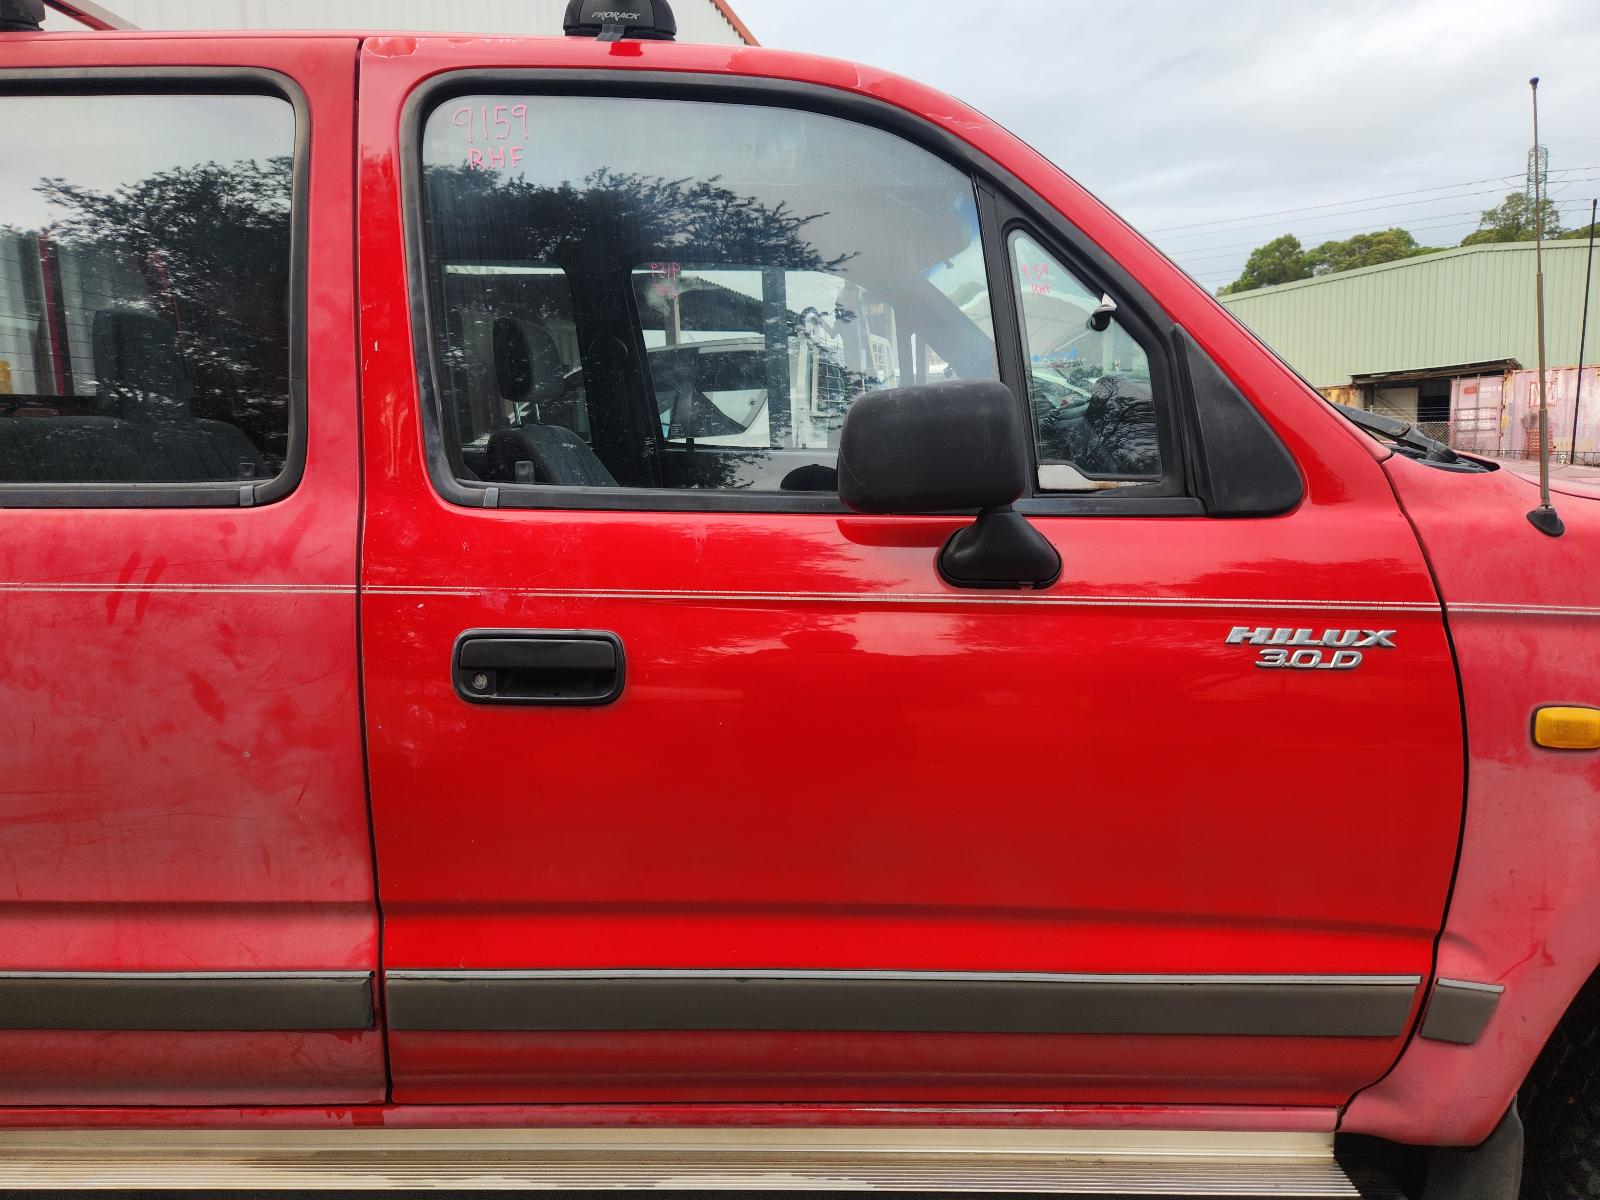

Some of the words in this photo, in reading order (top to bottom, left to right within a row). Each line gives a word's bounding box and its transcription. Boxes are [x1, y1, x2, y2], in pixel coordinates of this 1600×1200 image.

[591, 11, 641, 21] PRORACK
[451, 102, 528, 144] 9159
[469, 145, 523, 171] RHF
[1225, 626, 1397, 647] HILUX
